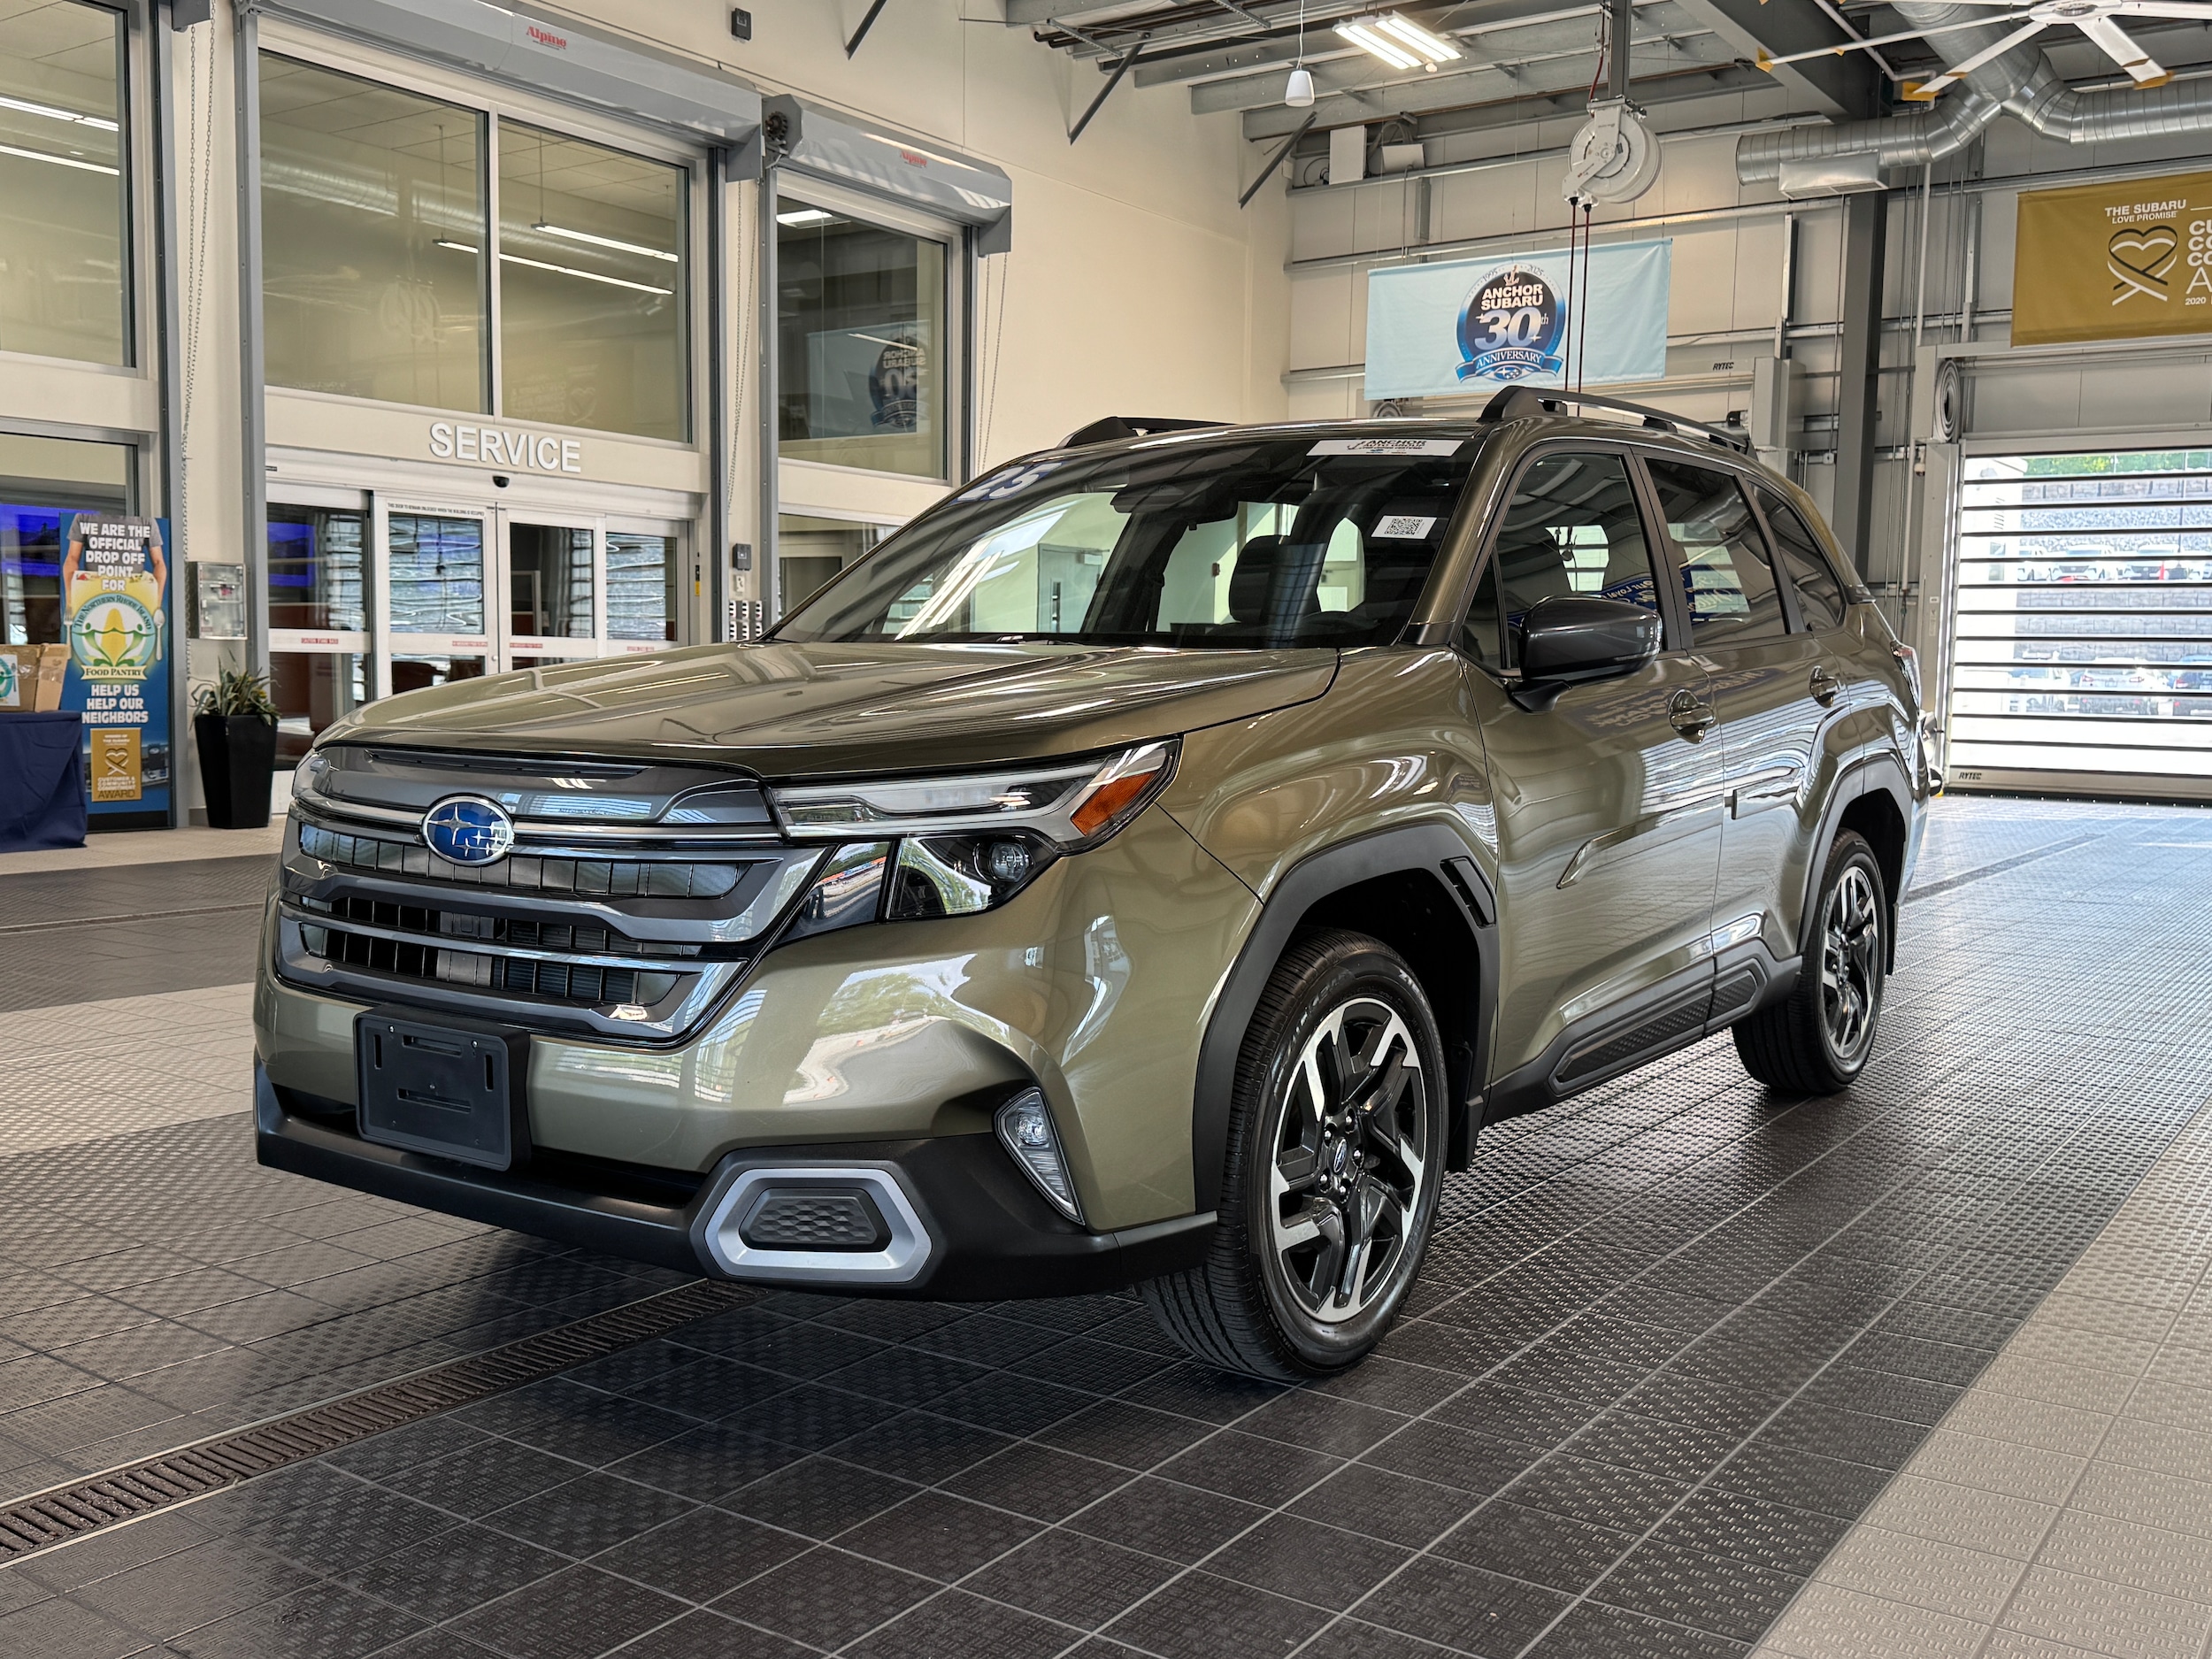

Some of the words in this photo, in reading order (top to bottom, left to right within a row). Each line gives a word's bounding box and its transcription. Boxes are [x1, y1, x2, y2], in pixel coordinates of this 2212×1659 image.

[526, 26, 566, 47] Alpine
[2105, 205, 2130, 217] THE
[2133, 199, 2186, 214] SUBARU
[2112, 215, 2134, 224] LOVE
[2137, 211, 2177, 221] PROMISE
[1527, 265, 1544, 276] 2025
[1482, 284, 1543, 300] ANCHOR
[1481, 295, 1543, 311] SUBARU
[2185, 296, 2207, 305] 2020
[1476, 350, 1541, 369] ANNIVERSARY
[429, 422, 581, 473] SERVICE
[956, 463, 1062, 501] 25
[80, 522, 98, 534] WE
[101, 524, 126, 536] ARE
[127, 525, 150, 537] THE
[88, 536, 142, 550] OFFICIAL
[86, 550, 119, 564] DROP
[122, 552, 145, 565] OFF
[98, 565, 134, 577] POINT
[102, 580, 126, 591] FOR
[81, 596, 115, 615] NORTHERN
[116, 595, 138, 608] RHODE
[136, 606, 151, 630] ISLAND
[91, 684, 121, 696] HELP
[124, 684, 139, 696] US
[87, 698, 117, 710] HELP
[119, 697, 143, 710] OUR
[81, 711, 149, 724] NEIGHBORS
[98, 790, 135, 799] AWARD
